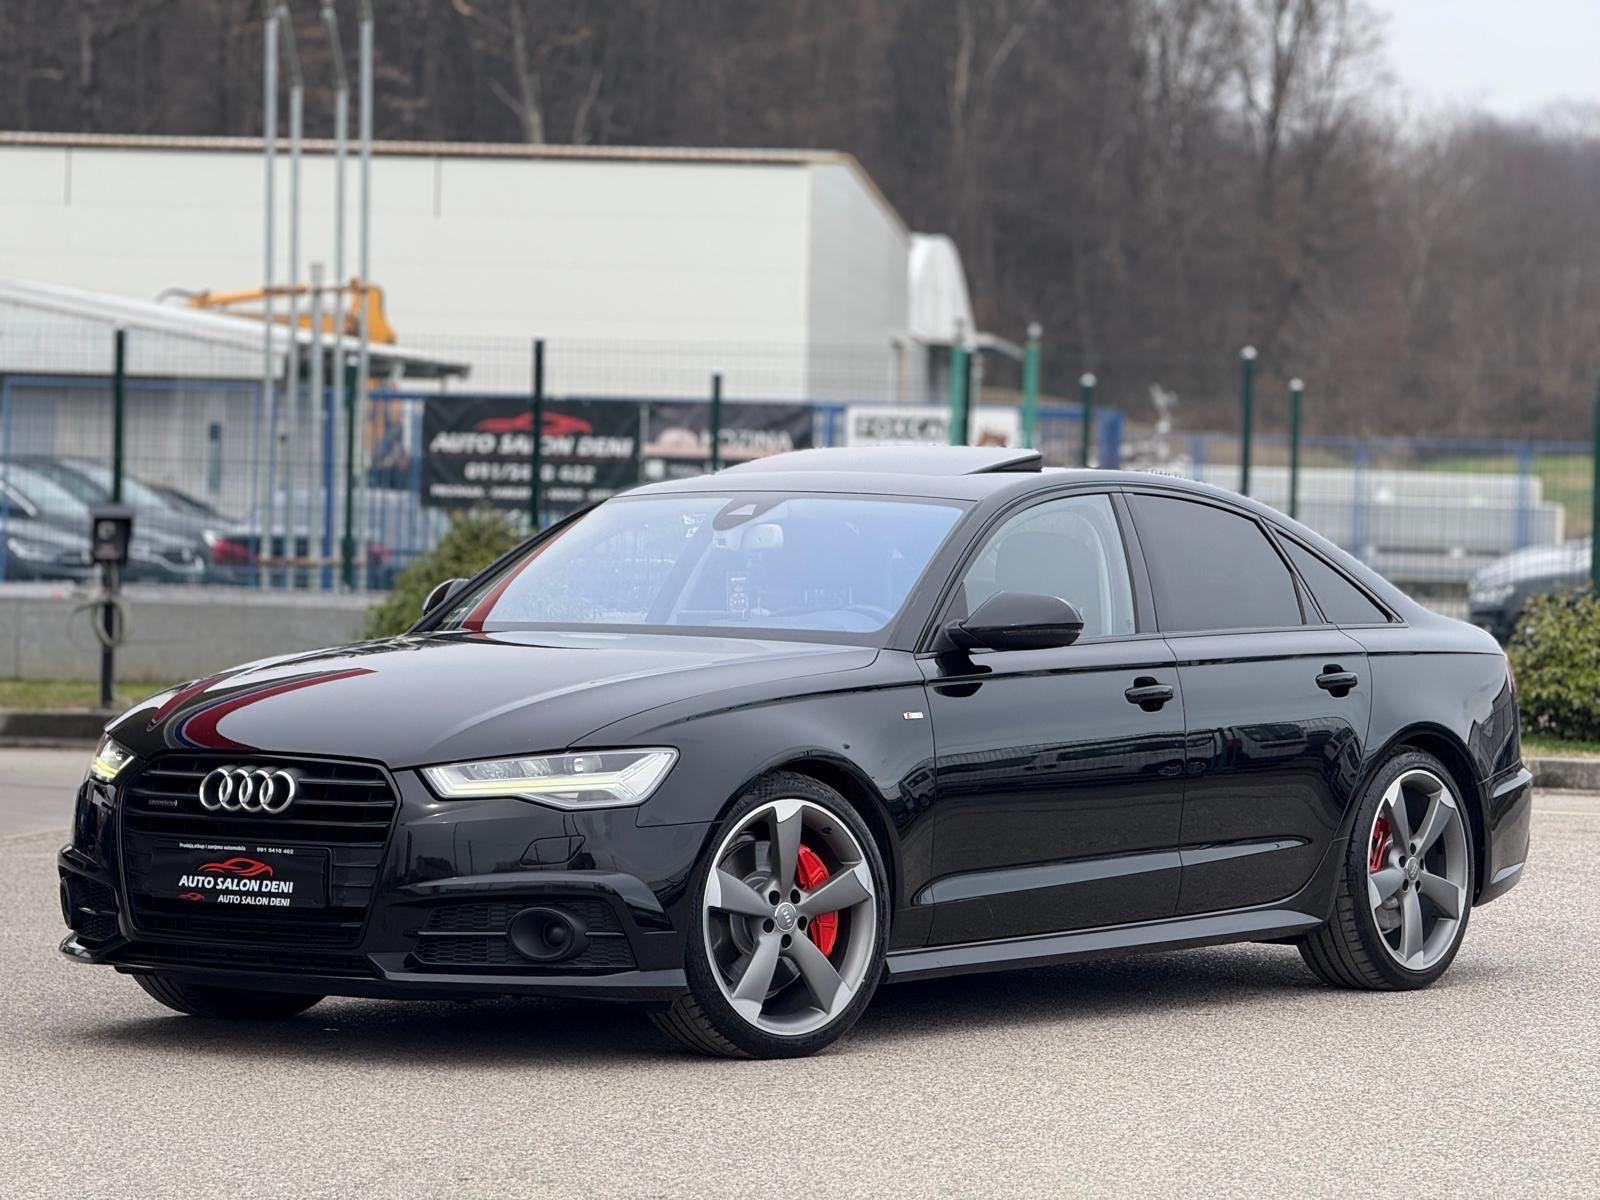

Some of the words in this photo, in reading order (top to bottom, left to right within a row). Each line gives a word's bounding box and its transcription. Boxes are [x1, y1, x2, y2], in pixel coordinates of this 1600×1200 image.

[429, 431, 496, 454] AUTO
[575, 436, 634, 458] DENI
[178, 875, 215, 889] AUTO
[215, 877, 260, 892] SALON
[261, 880, 294, 894] DENI
[217, 894, 241, 904] AUTO
[240, 896, 270, 906] SALON
[269, 897, 291, 907] DENI
